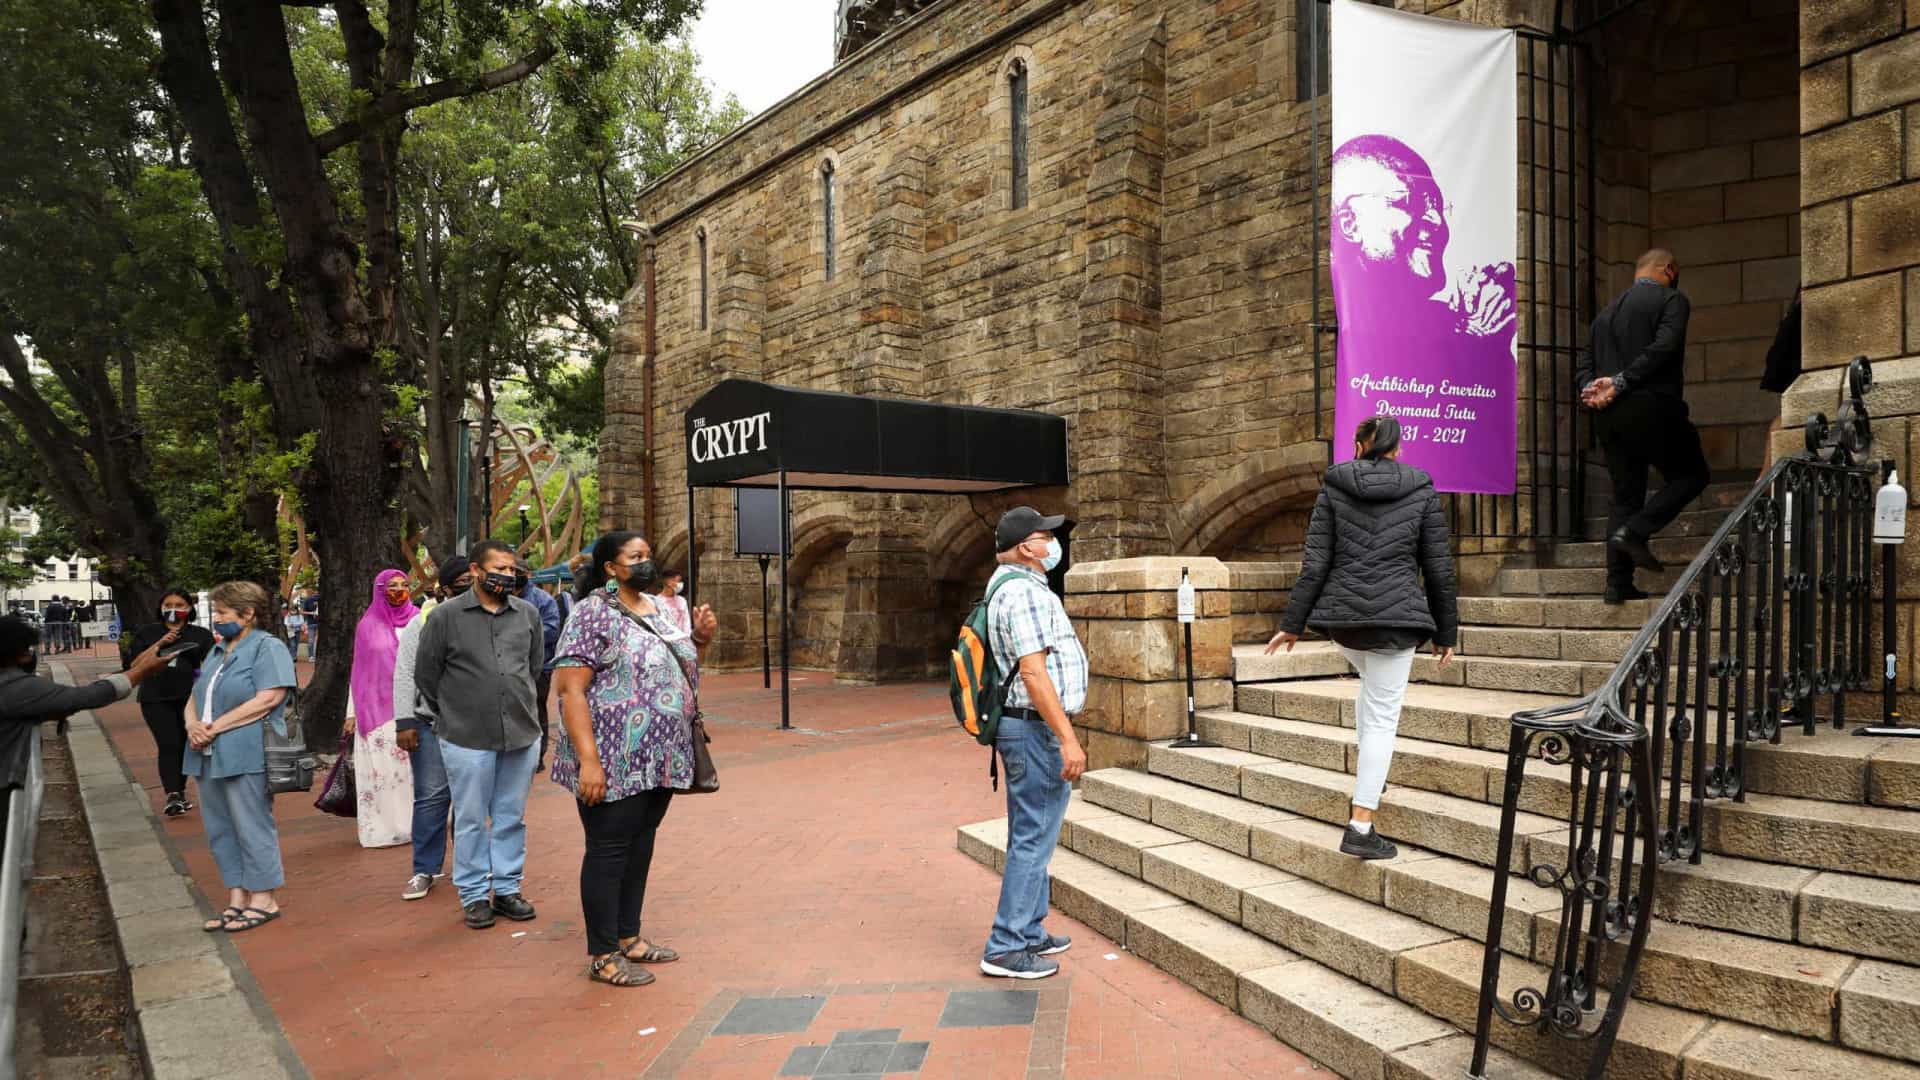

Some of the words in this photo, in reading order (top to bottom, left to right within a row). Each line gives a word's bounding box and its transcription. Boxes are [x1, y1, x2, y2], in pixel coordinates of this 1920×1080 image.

[1350, 373, 1435, 398] Archbishop
[1439, 379, 1497, 399] Emeritus
[1375, 399, 1440, 419] Desmond
[1443, 404, 1477, 421] Tutu
[693, 417, 706, 428] THE
[691, 411, 771, 463] CRYPT
[1432, 426, 1467, 444] 2021
